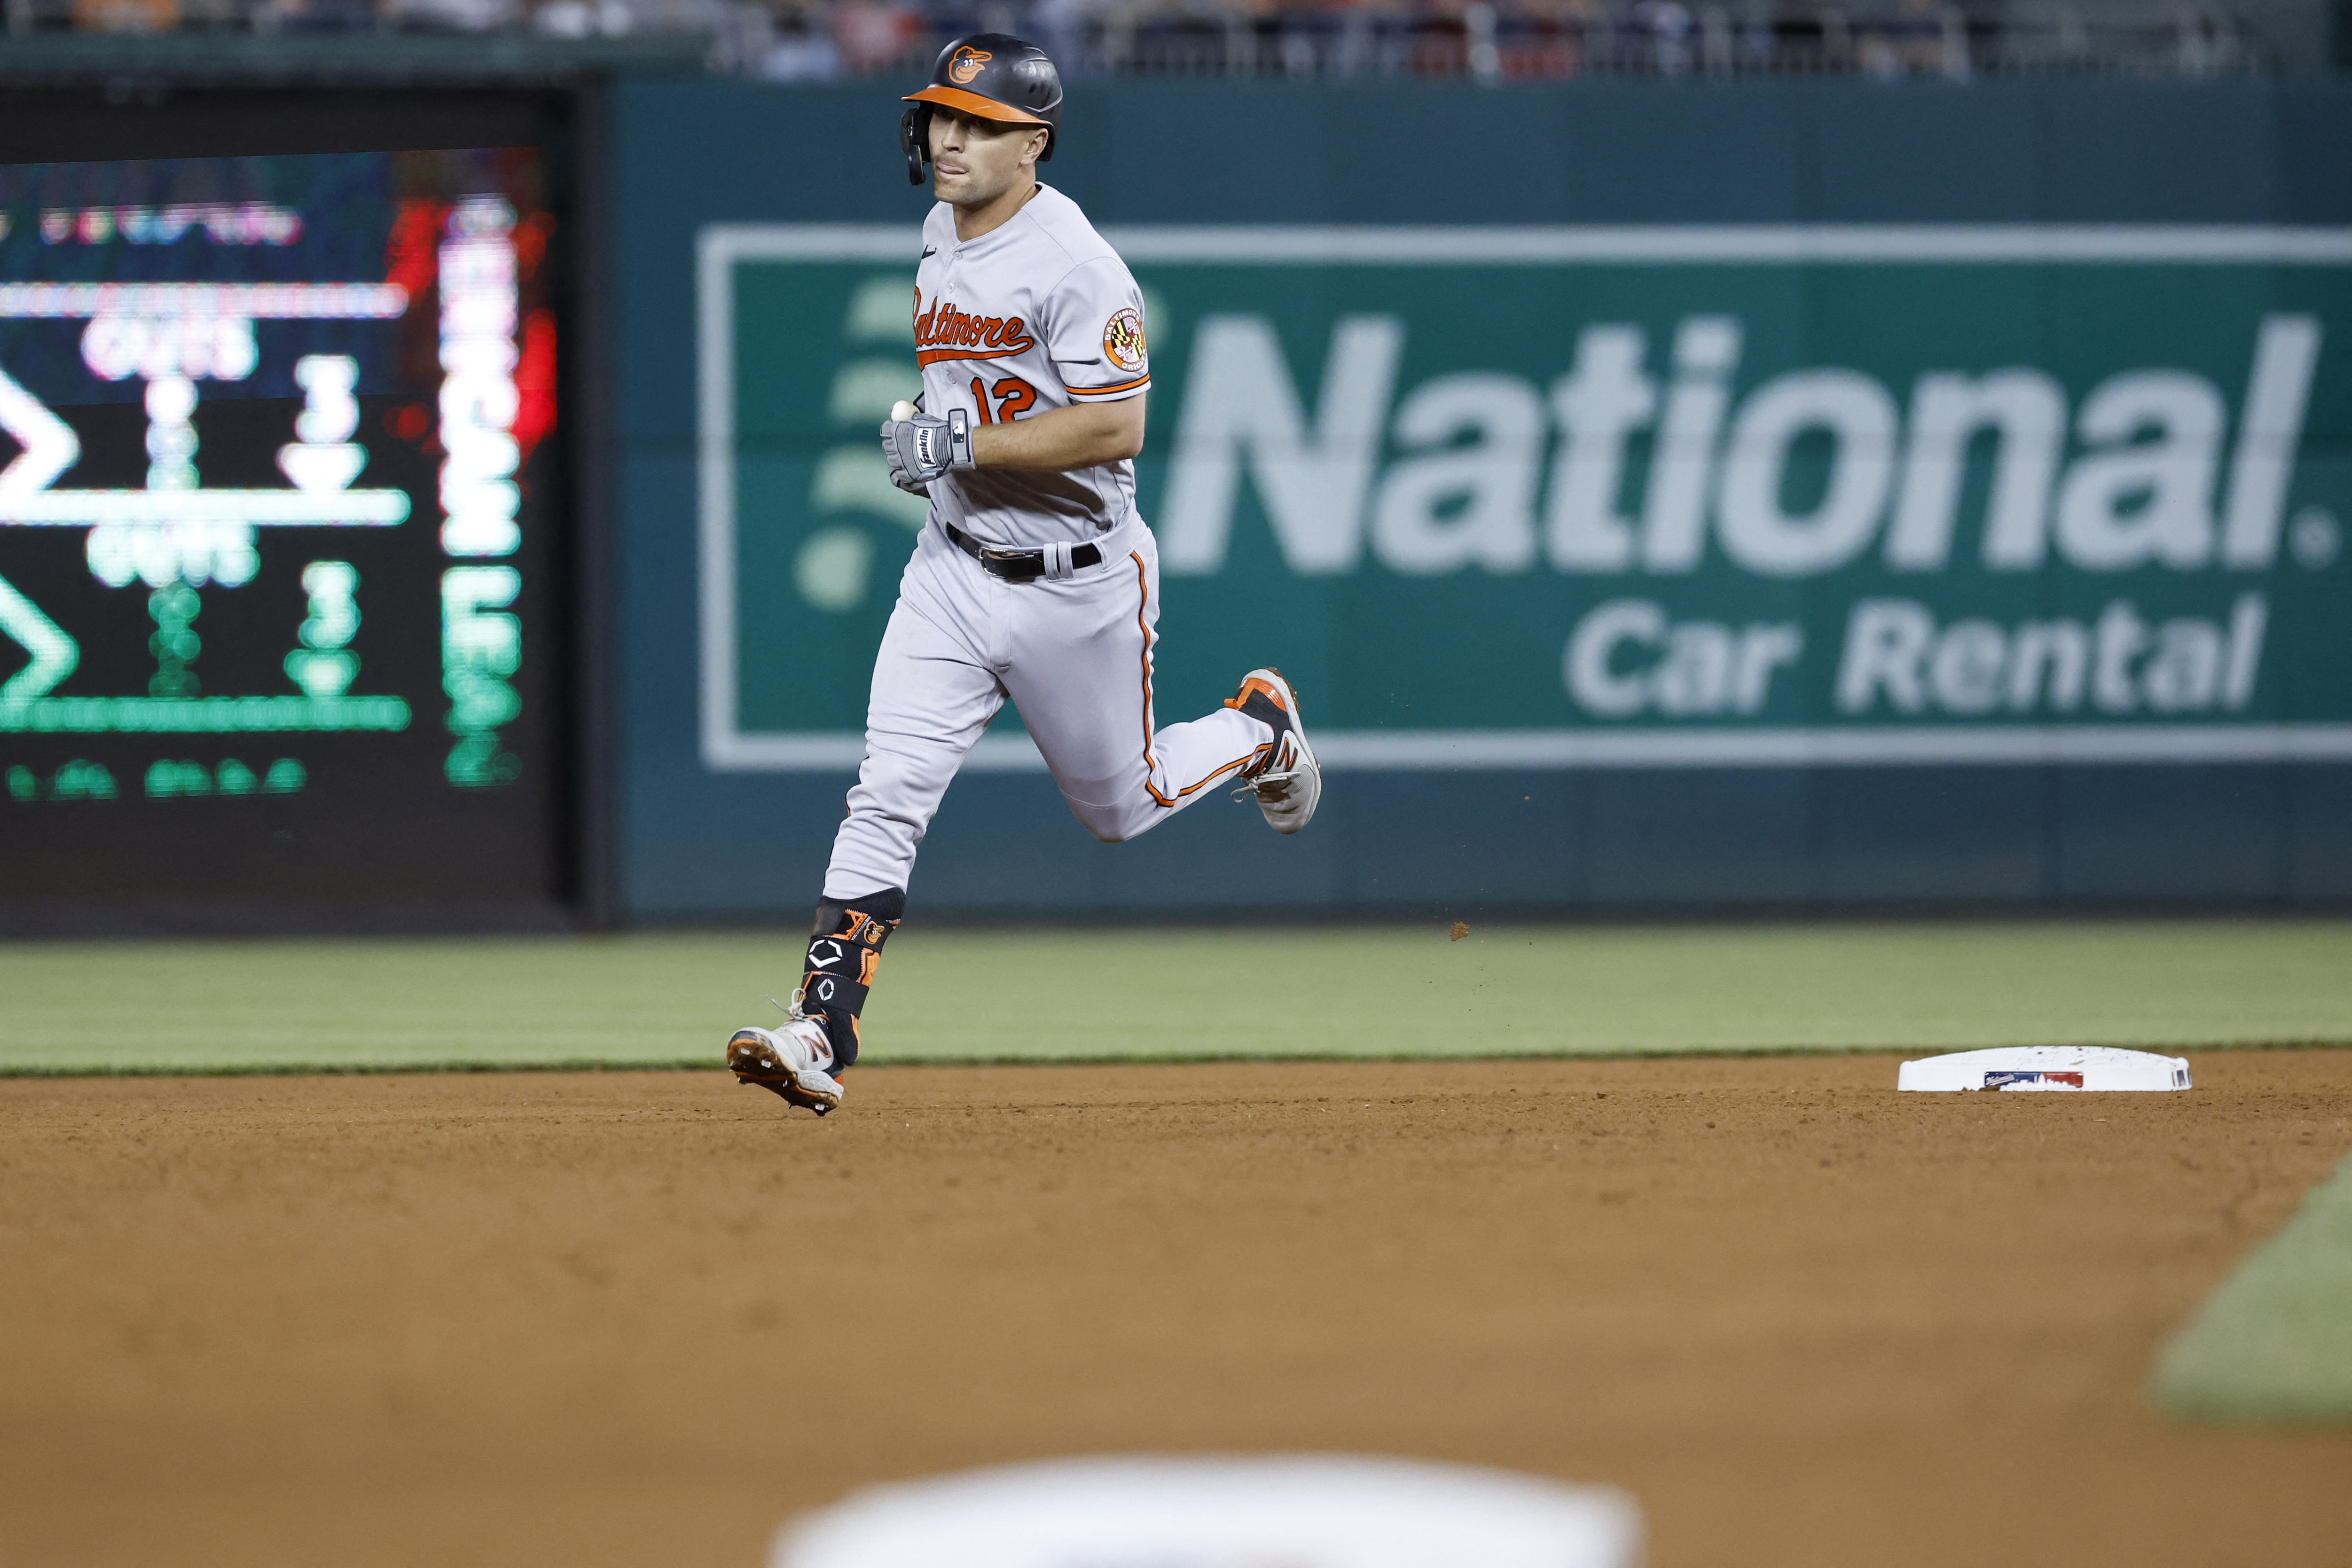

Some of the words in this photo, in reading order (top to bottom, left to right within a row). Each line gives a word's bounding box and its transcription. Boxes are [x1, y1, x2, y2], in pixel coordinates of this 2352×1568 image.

[970, 376, 1037, 425] 12
[919, 429, 935, 465] Franklin
[1159, 315, 2318, 574] National
[1566, 601, 1800, 713] Car
[1838, 596, 2265, 711] Rental
